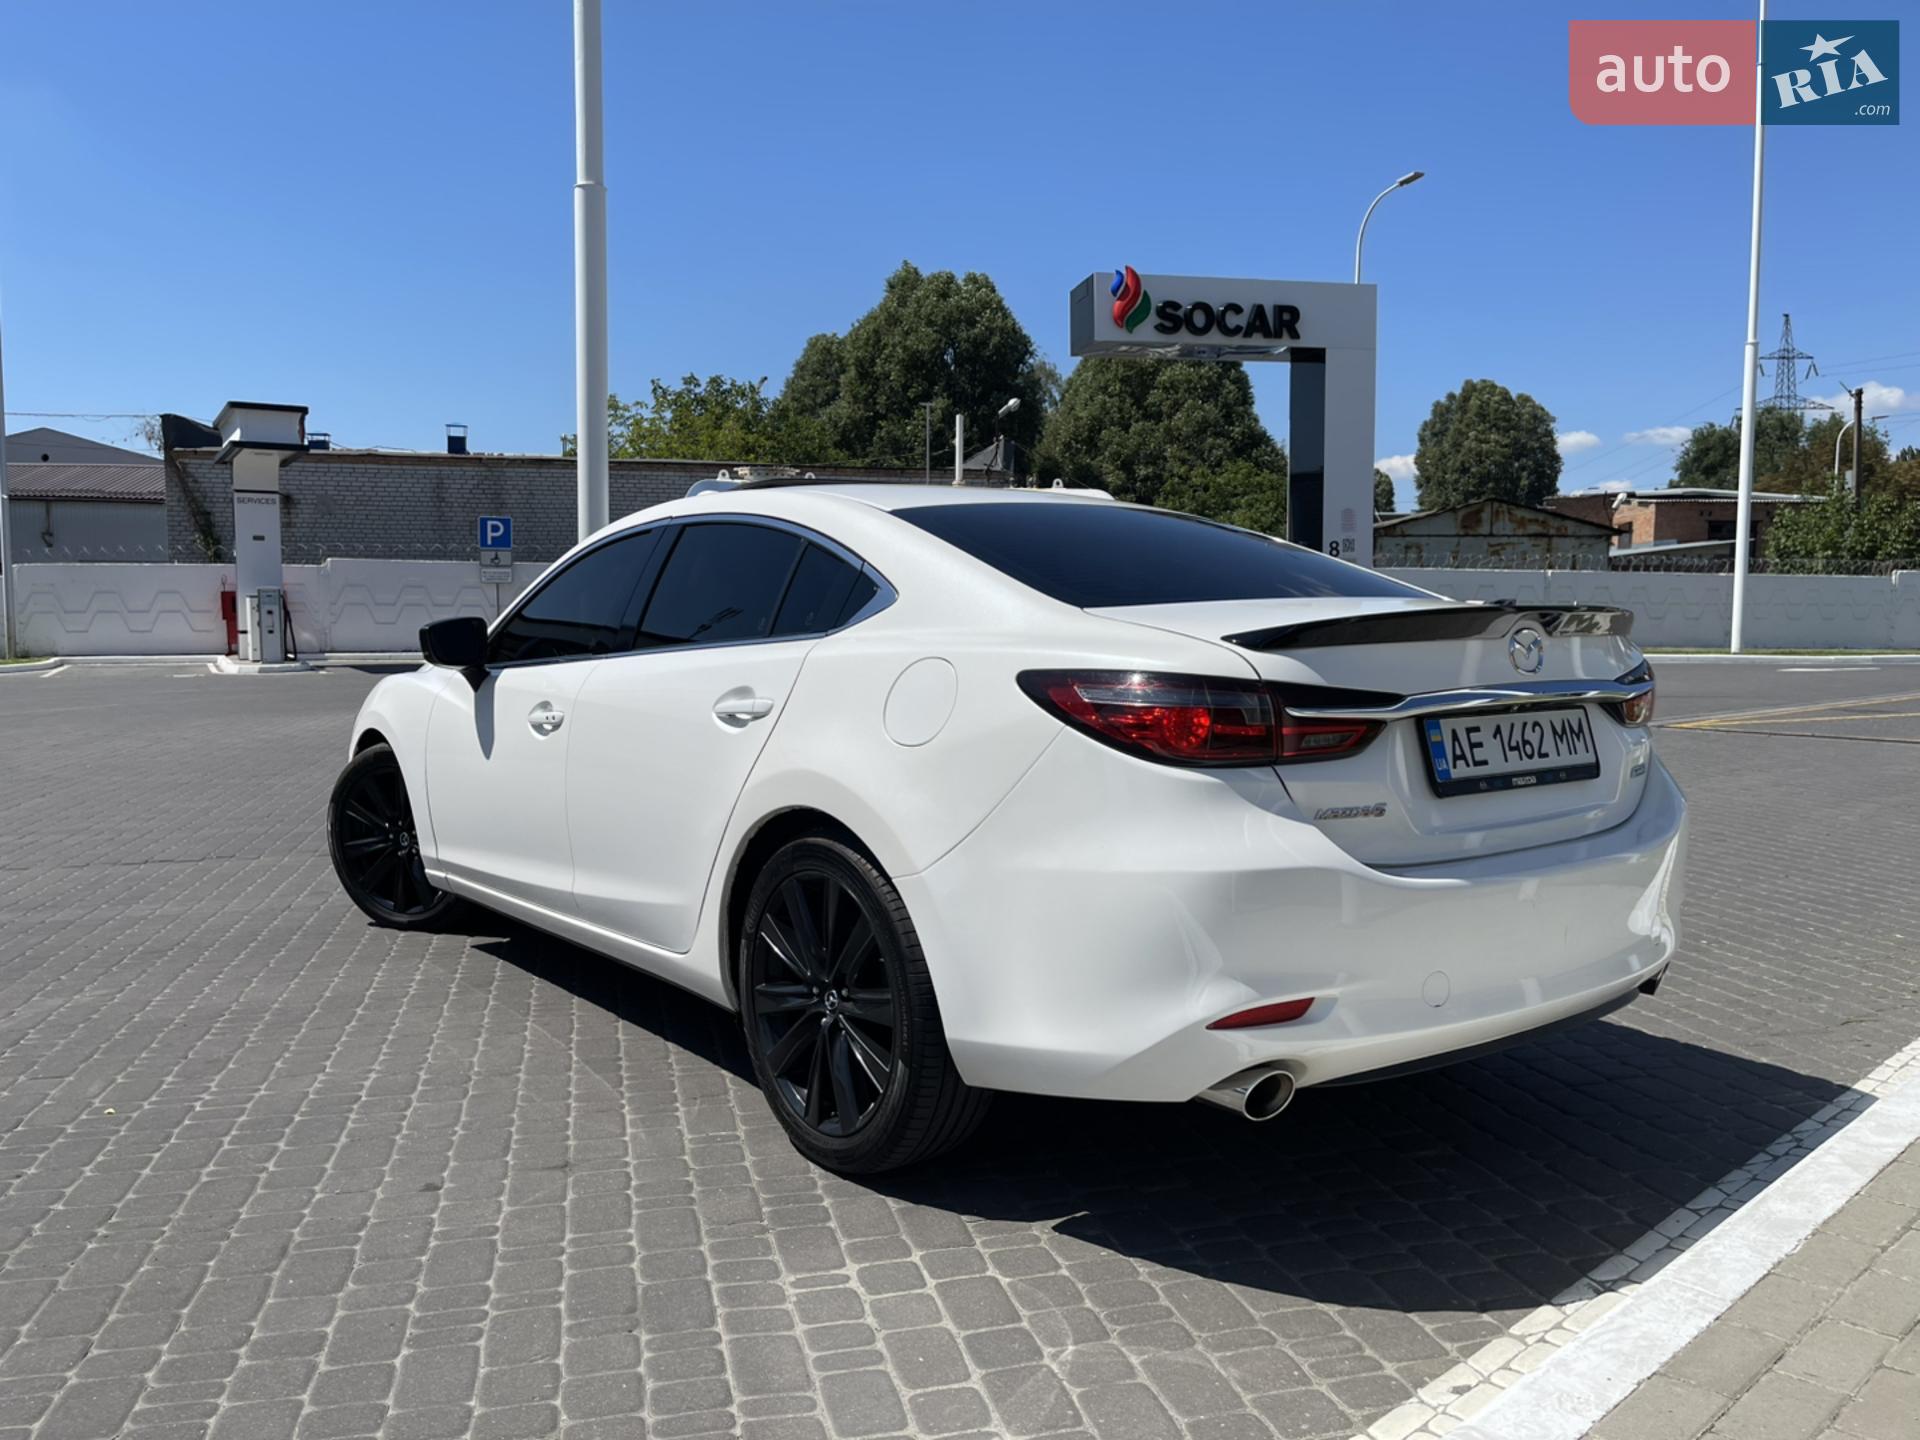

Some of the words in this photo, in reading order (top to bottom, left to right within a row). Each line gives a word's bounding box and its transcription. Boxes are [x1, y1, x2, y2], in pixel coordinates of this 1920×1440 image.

[1153, 299, 1301, 340] SOCAR
[236, 496, 277, 506] SERVICES
[487, 520, 504, 545] P
[1329, 540, 1340, 557] 8
[1451, 726, 1489, 769] AE
[1492, 720, 1550, 763] 1462
[1549, 716, 1589, 757] MM
[1435, 758, 1448, 770] UA
